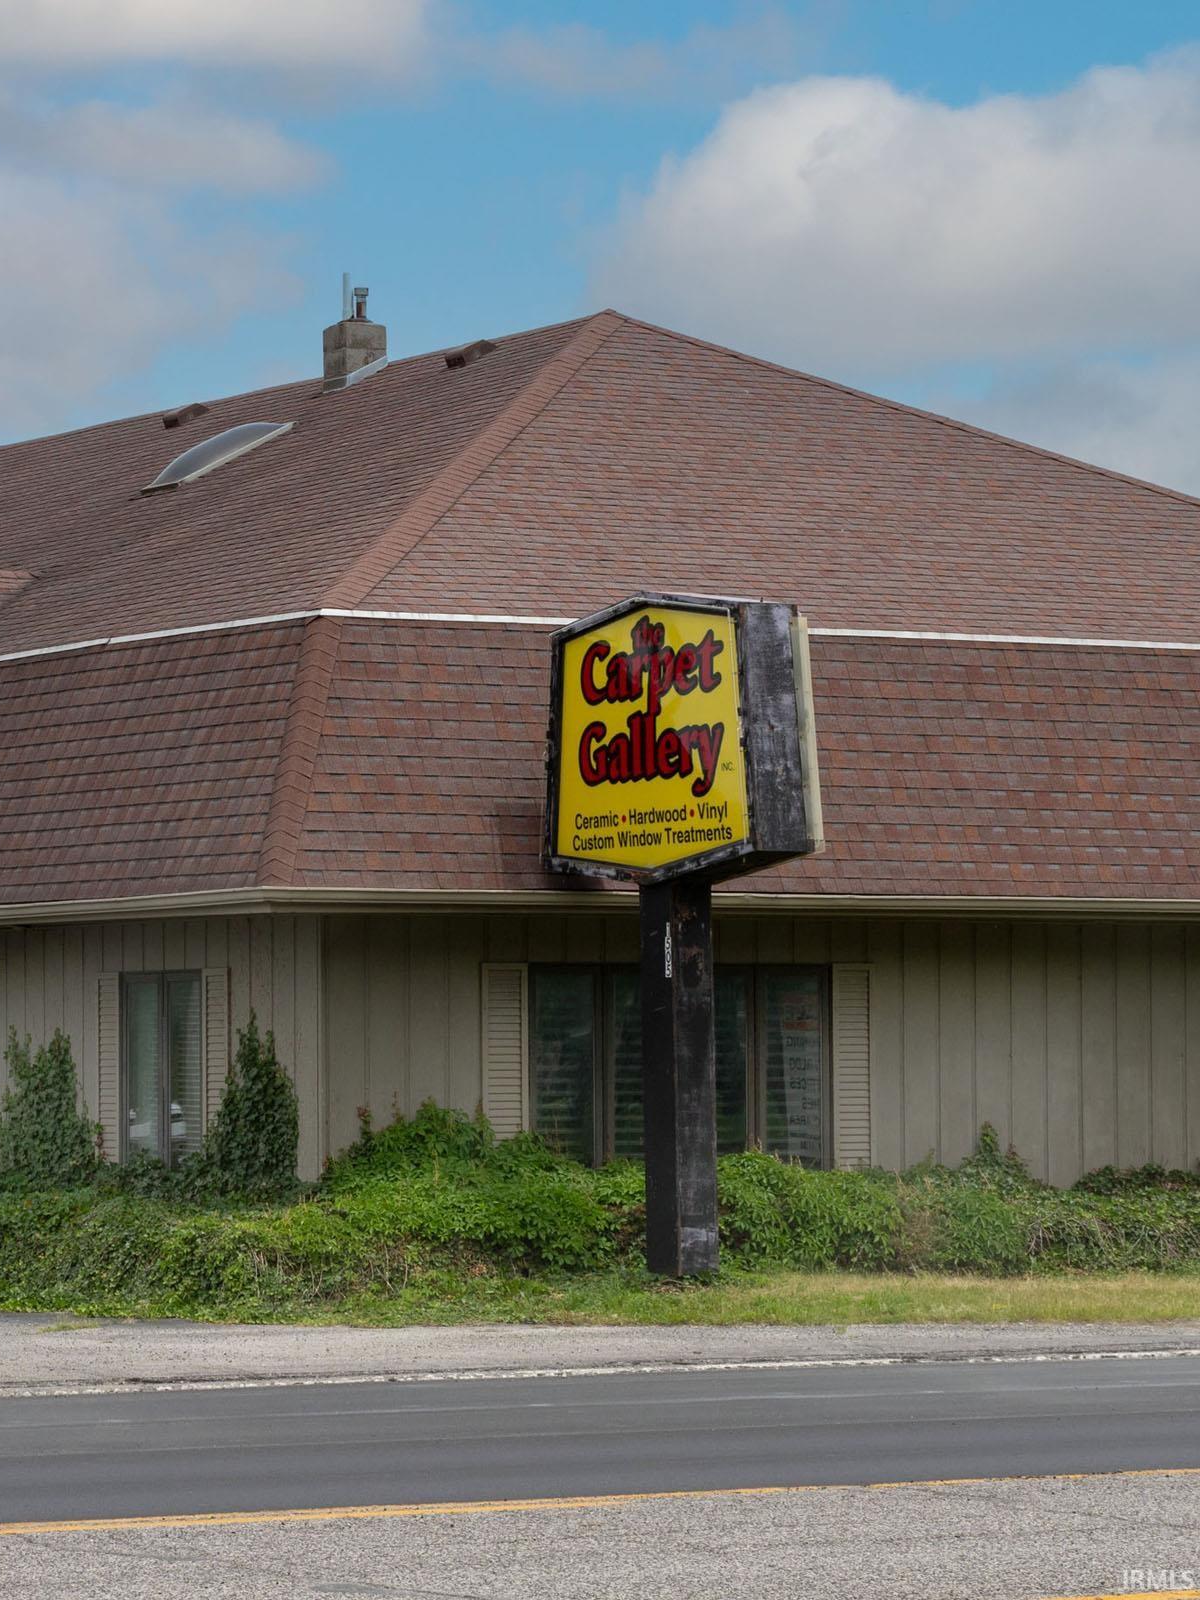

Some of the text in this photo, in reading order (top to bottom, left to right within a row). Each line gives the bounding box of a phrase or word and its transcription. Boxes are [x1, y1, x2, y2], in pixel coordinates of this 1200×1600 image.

[632, 615, 665, 650] the
[581, 629, 724, 715] Carpet
[578, 711, 724, 797] Gallery
[575, 801, 728, 830] Ceramic Hardwood Vinyl
[572, 824, 732, 851] Custom Window Treatments
